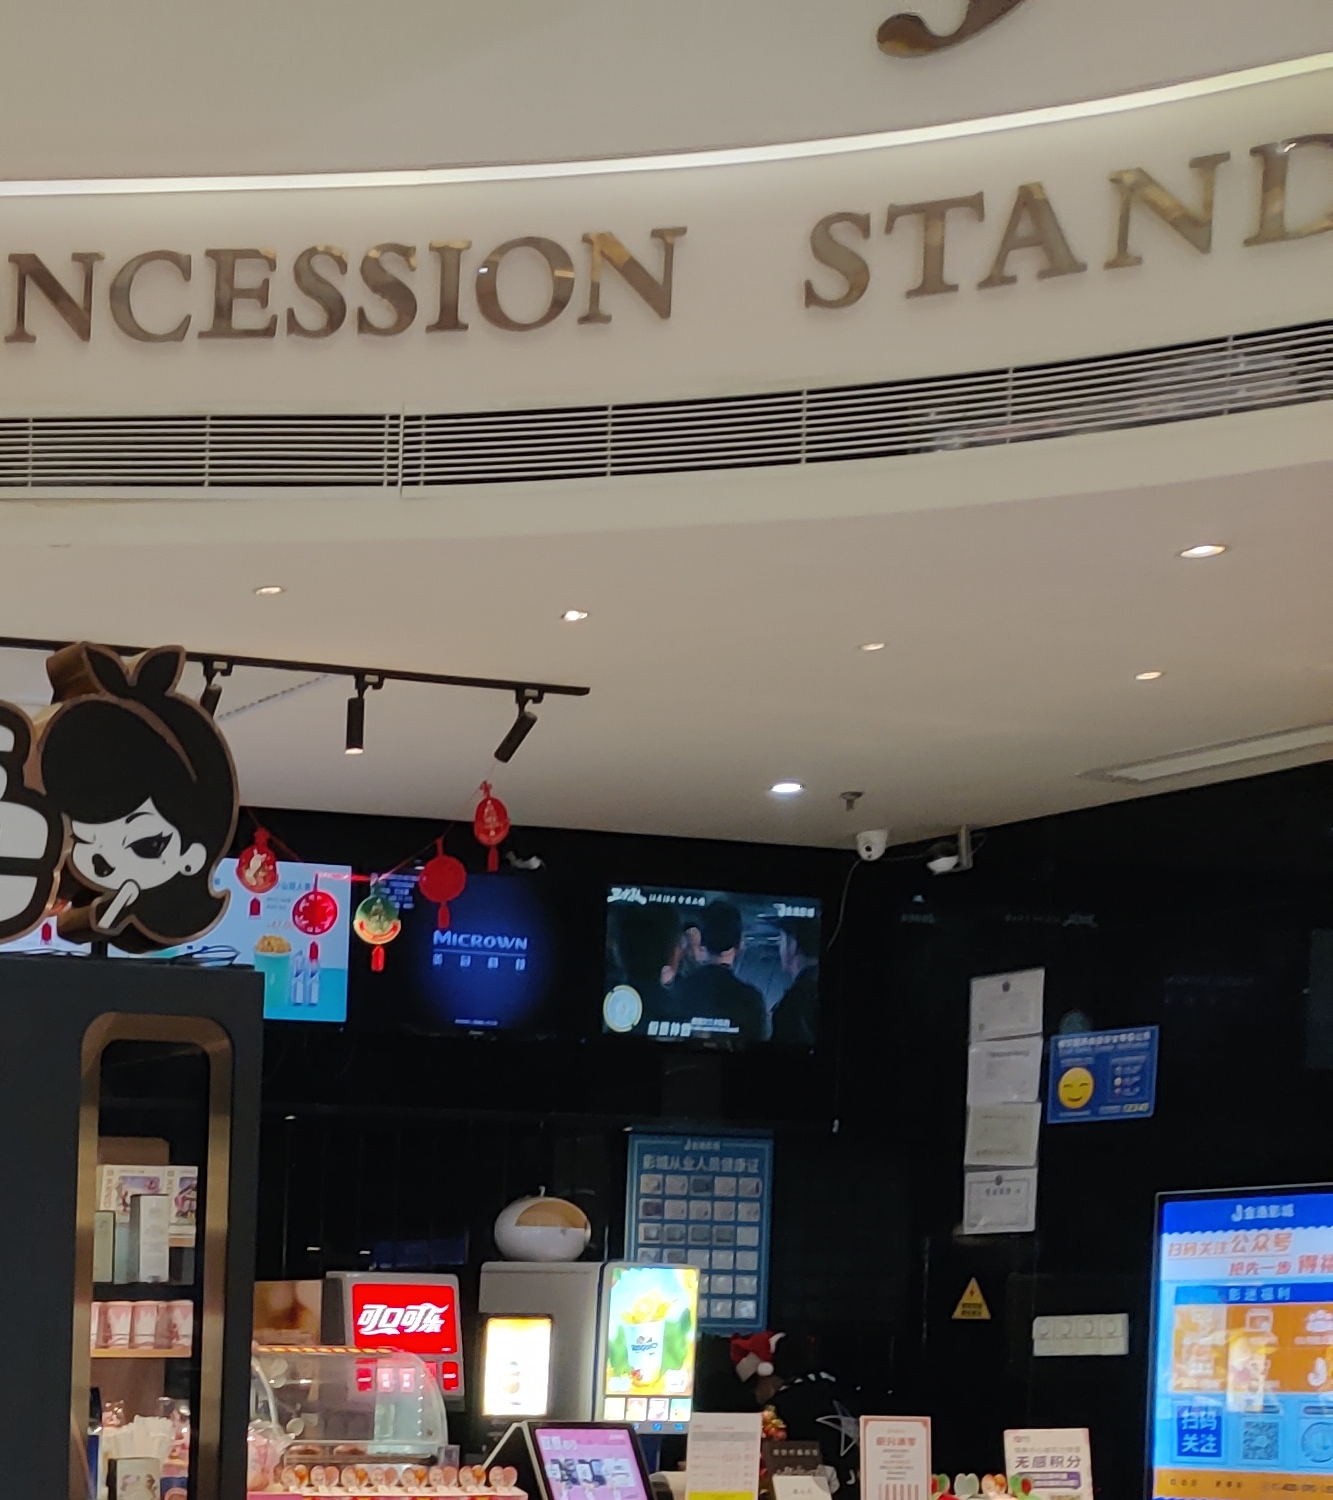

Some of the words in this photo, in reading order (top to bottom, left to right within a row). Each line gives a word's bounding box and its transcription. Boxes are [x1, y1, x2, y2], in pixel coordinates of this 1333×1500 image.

[803, 131, 1333, 311] STAND
[433, 929, 528, 951] MICROWN
[357, 1302, 449, 1335] 可口可乐
[1181, 1410, 1218, 1431] 扫码
[1181, 1433, 1218, 1454] 关注
